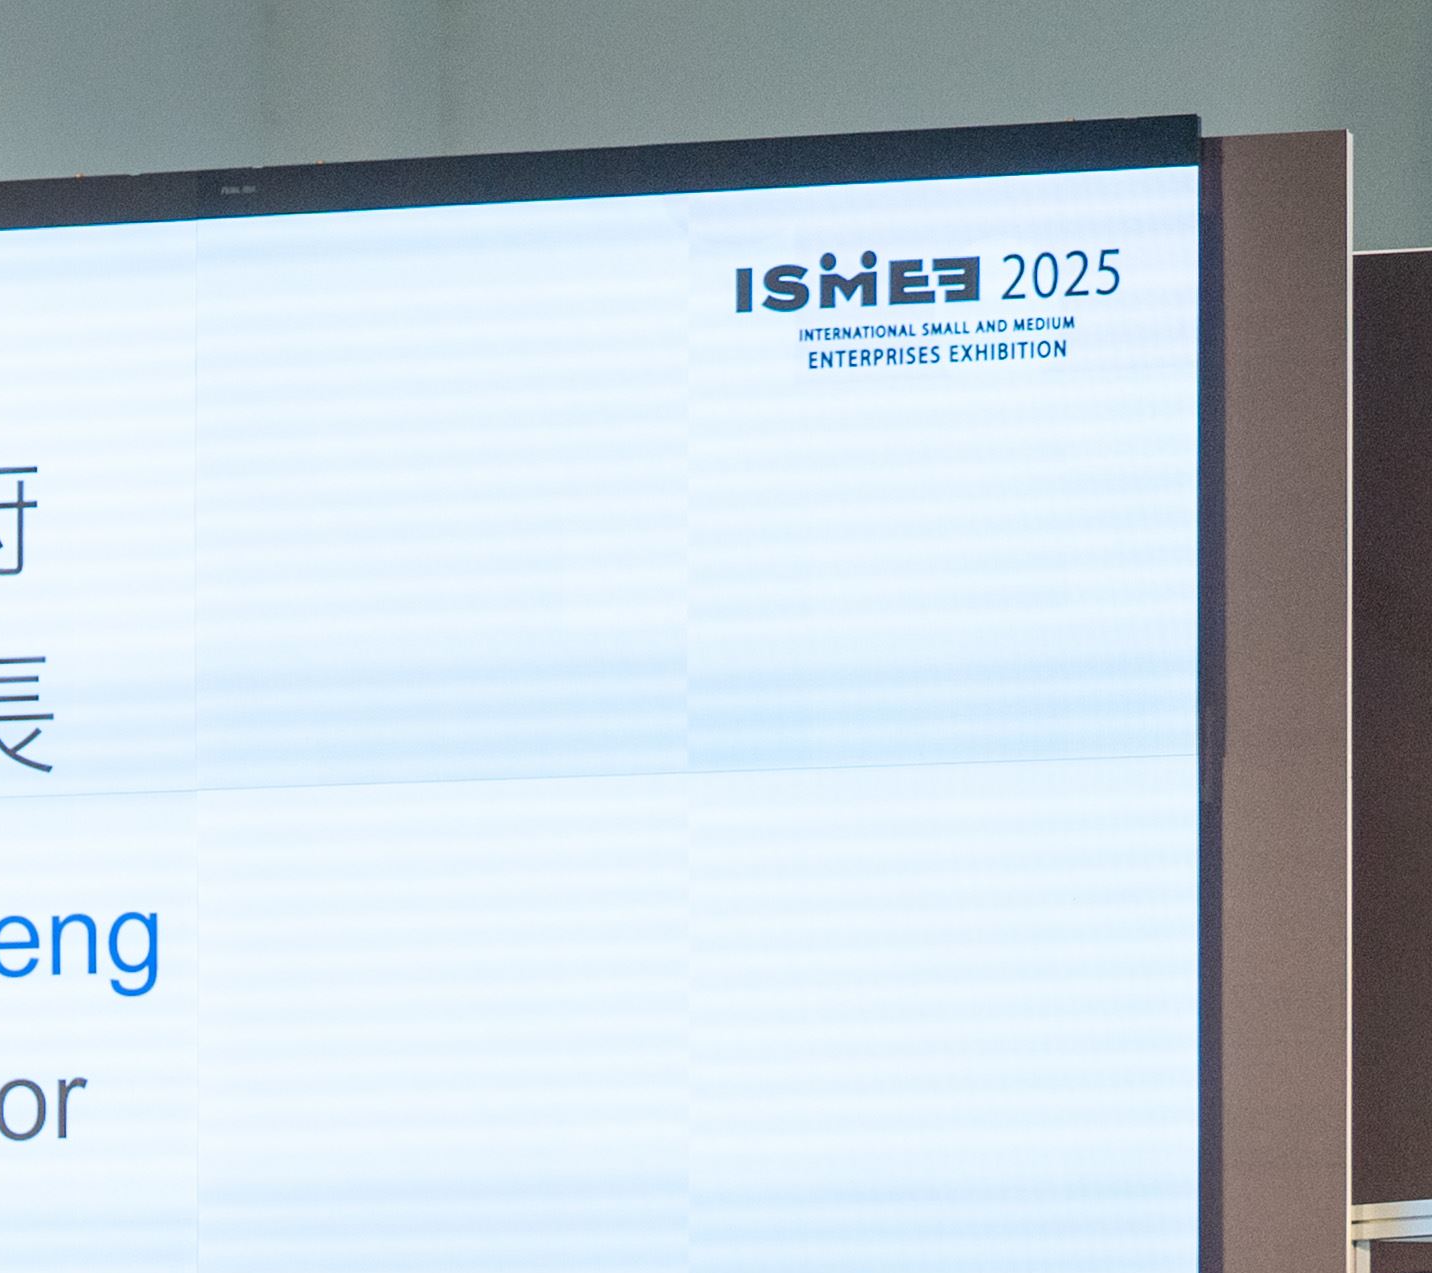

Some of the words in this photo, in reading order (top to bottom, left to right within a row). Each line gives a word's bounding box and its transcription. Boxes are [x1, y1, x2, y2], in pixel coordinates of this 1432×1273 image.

[736, 250, 980, 313] ISMEE
[1001, 249, 1120, 300] 2025
[799, 323, 917, 342] INTERNATIONAL
[921, 321, 970, 337] SMALL
[975, 319, 1008, 334] AND
[1012, 316, 1075, 331] MEDIUM
[808, 345, 941, 369] ENTERPRISES
[949, 339, 1067, 363] EXHIBITION
